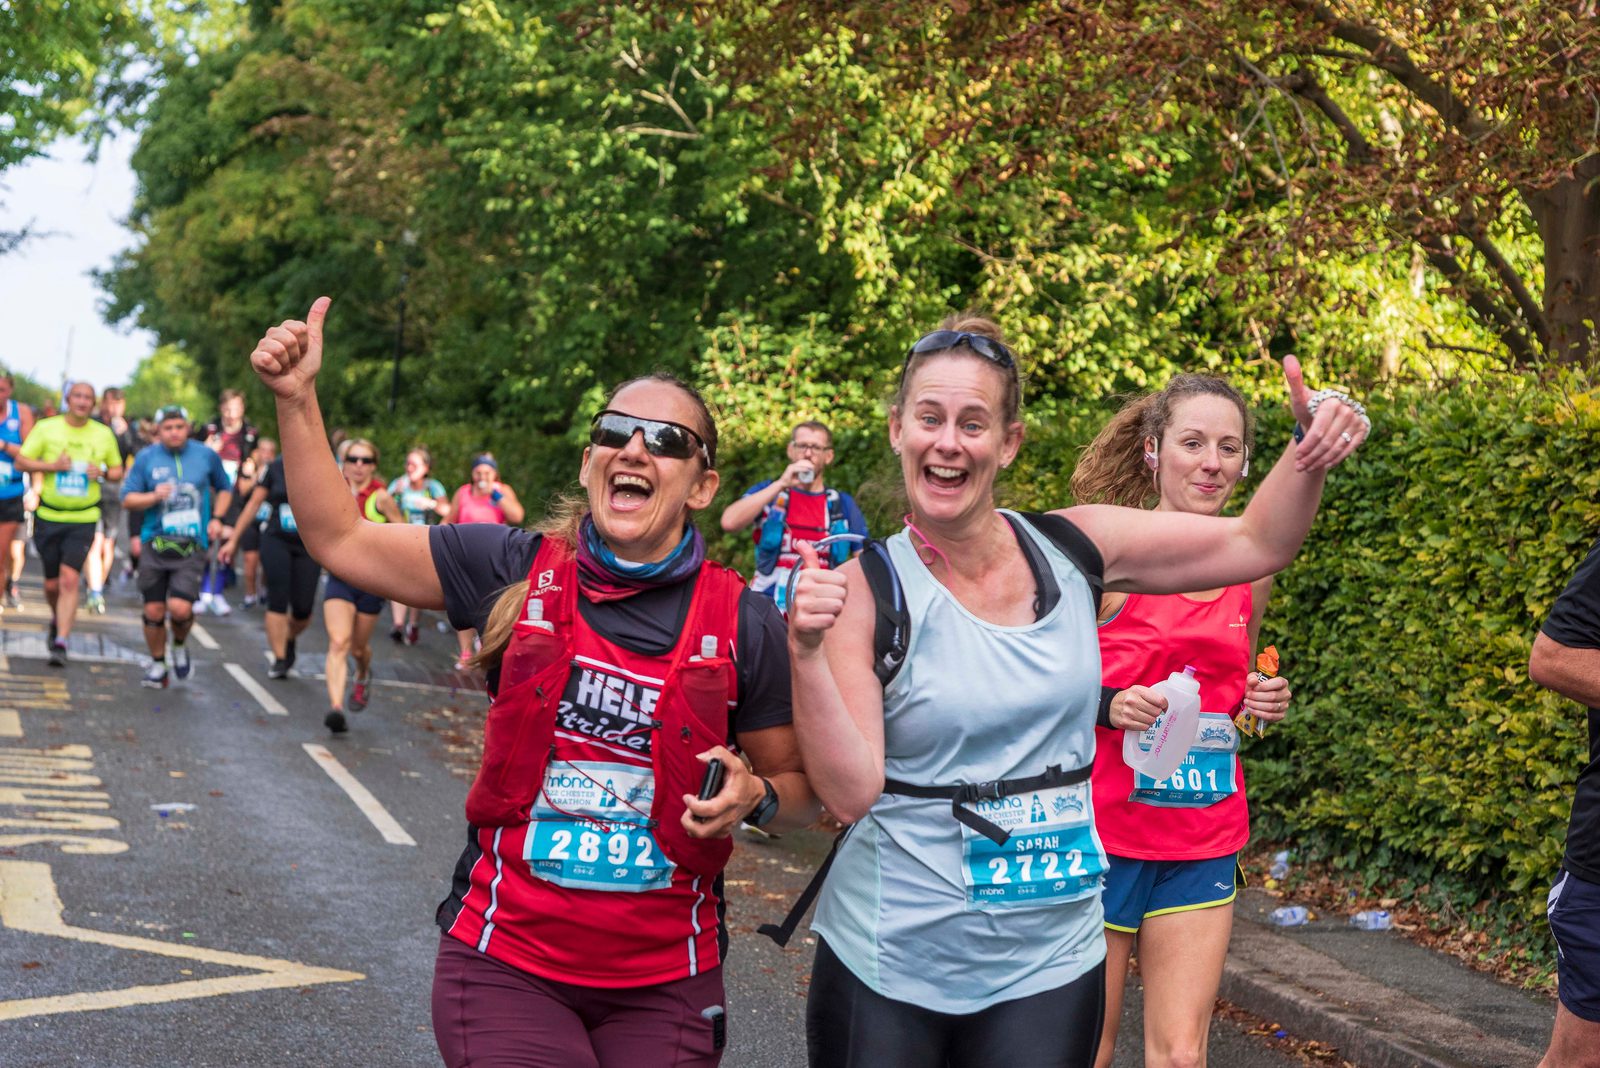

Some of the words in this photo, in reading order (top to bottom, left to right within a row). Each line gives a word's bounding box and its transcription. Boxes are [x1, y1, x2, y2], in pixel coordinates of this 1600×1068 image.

[556, 701, 652, 750] tride
[547, 774, 593, 789] mbna
[561, 790, 596, 798] CHESTER
[550, 798, 592, 806] ARATHON
[548, 829, 655, 867] 2892
[1016, 836, 1060, 852] SARAH
[988, 849, 1089, 885] 2722
[980, 886, 1005, 895] mbna
